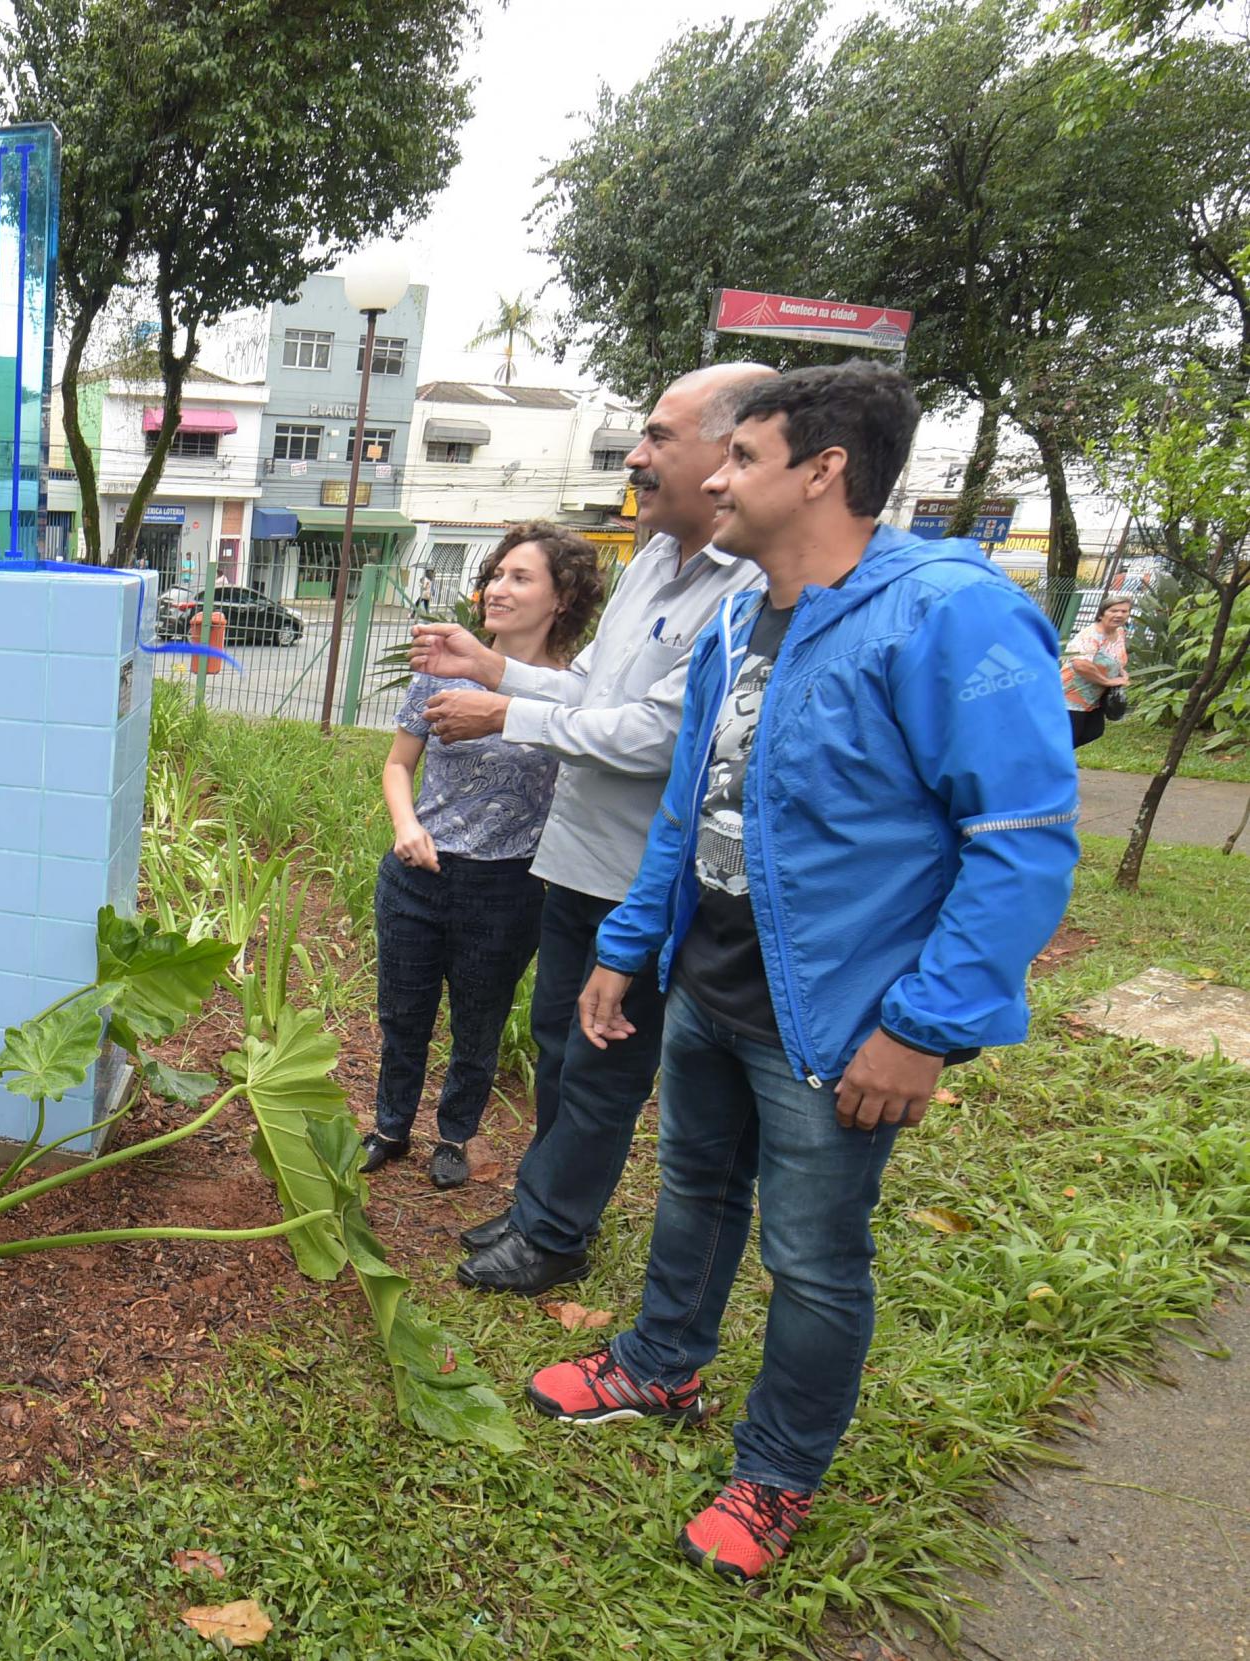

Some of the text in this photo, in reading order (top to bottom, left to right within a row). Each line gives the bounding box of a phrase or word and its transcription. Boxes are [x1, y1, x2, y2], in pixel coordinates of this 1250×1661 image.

[779, 301, 858, 321] Acontece na cidade
[980, 504, 1007, 513] Clima
[958, 671, 1038, 702] adidas
